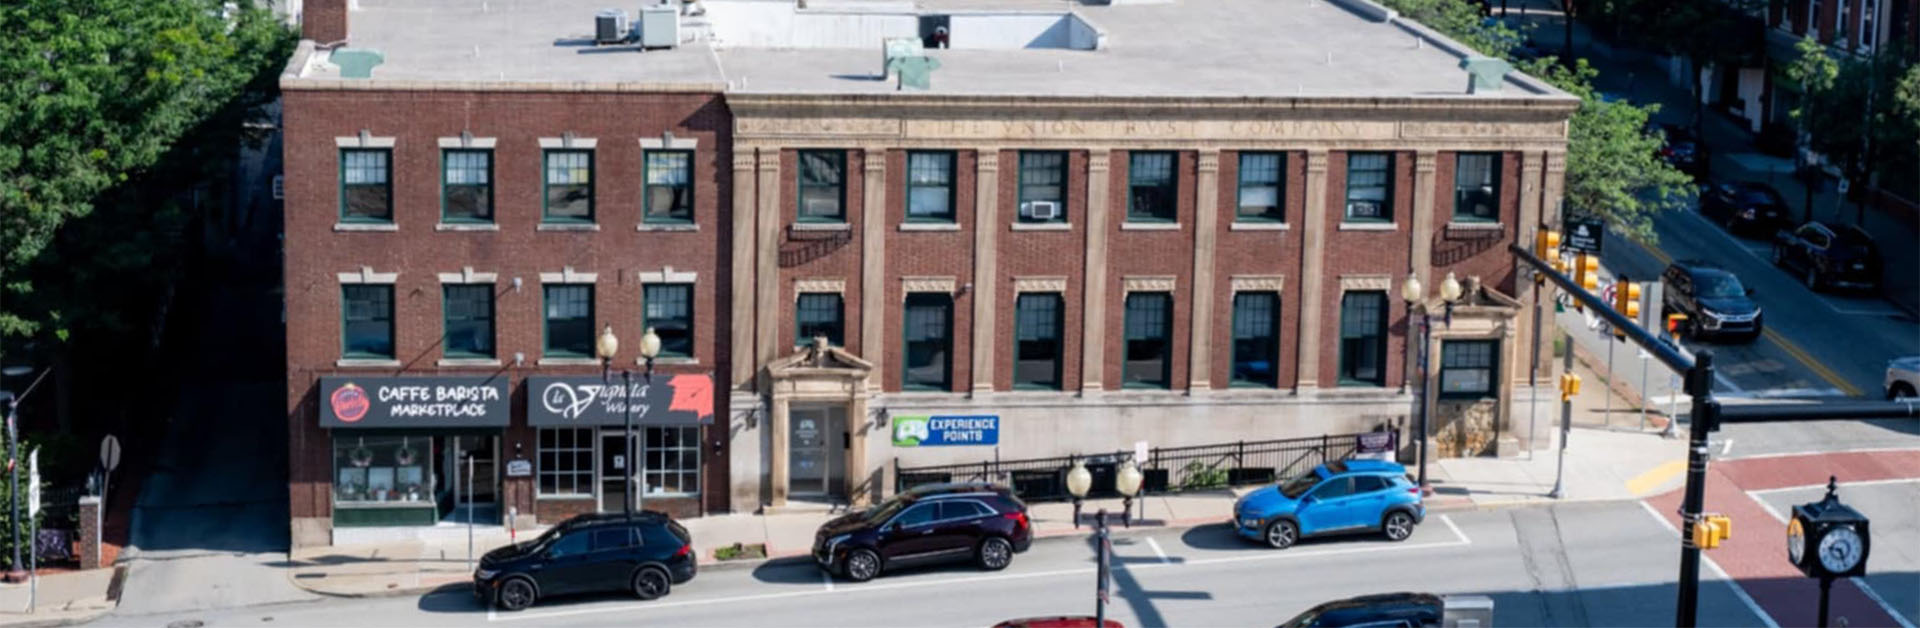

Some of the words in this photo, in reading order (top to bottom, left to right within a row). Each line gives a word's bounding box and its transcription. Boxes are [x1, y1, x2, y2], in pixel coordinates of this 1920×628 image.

[1230, 120, 1362, 135] COMPANY
[378, 386, 430, 402] CAFFE
[436, 386, 499, 402] BARISTA
[390, 403, 486, 417] MARKETPLACE
[930, 418, 996, 431] EXPERIENCE
[943, 430, 983, 442] POINTS
